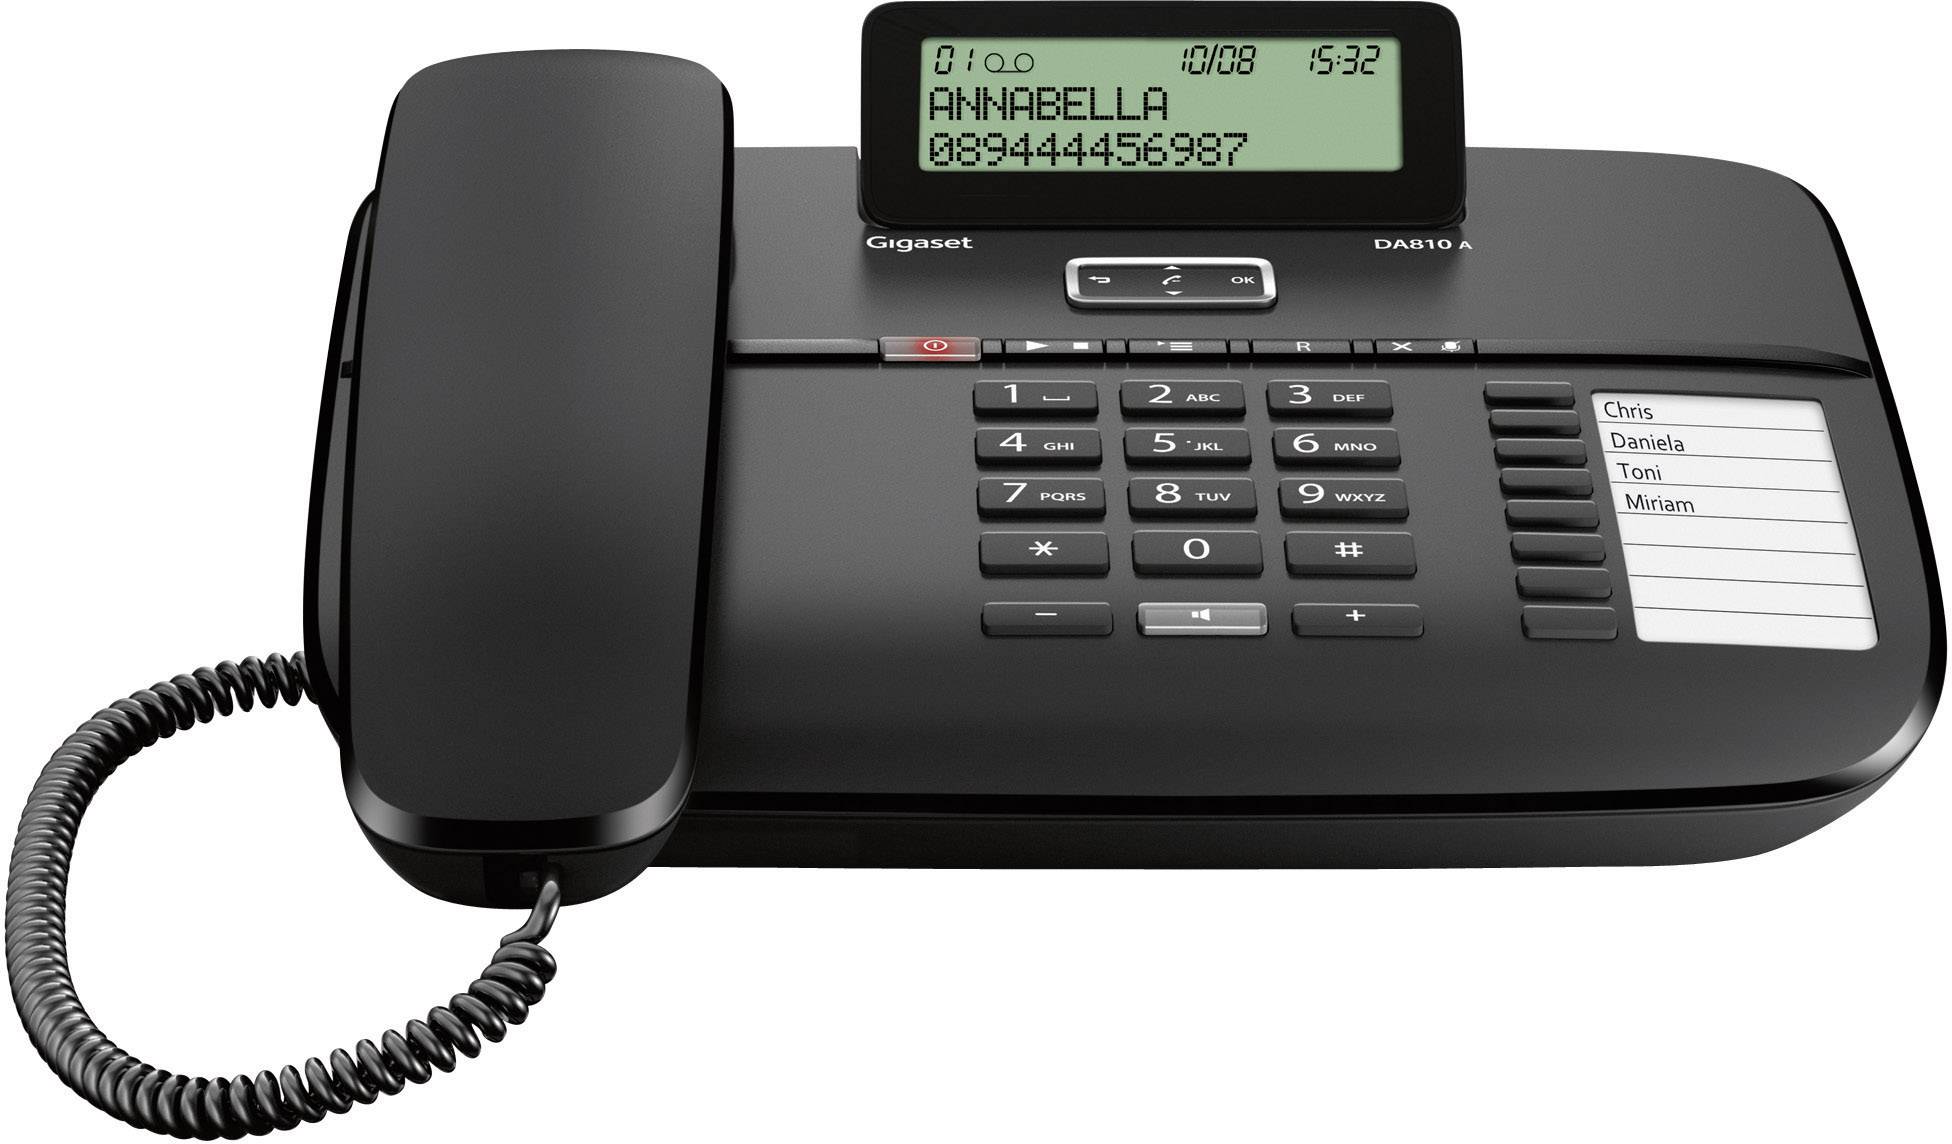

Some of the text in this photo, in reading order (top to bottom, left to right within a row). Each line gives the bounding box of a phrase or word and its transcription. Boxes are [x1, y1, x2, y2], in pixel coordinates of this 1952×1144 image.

[1181, 43, 1257, 76] 10/08
[1309, 44, 1381, 76] 15:32
[929, 86, 1168, 121] ANNABELLA
[929, 132, 1248, 167] 089444456987
[866, 235, 973, 253] Gigaset
[1374, 239, 1473, 250] DA810 A
[1231, 276, 1255, 284] OK
[1296, 341, 1312, 352] R
[1004, 383, 1017, 404] 1
[1148, 384, 1221, 404] 2 ABC
[1288, 384, 1365, 405] 3 DEF
[1603, 400, 1654, 420] Chris
[999, 432, 1074, 452] 4 GHI
[1152, 432, 1224, 453] 5 JKL
[1293, 432, 1377, 453] 6 MNO
[1610, 432, 1685, 452] Daniela
[1615, 462, 1662, 481] Toni
[1003, 482, 1086, 503] 7 PQRS
[1155, 482, 1231, 504] 8 TUV
[1298, 483, 1386, 504] 9 WXYZ
[1625, 493, 1695, 513] Miriam
